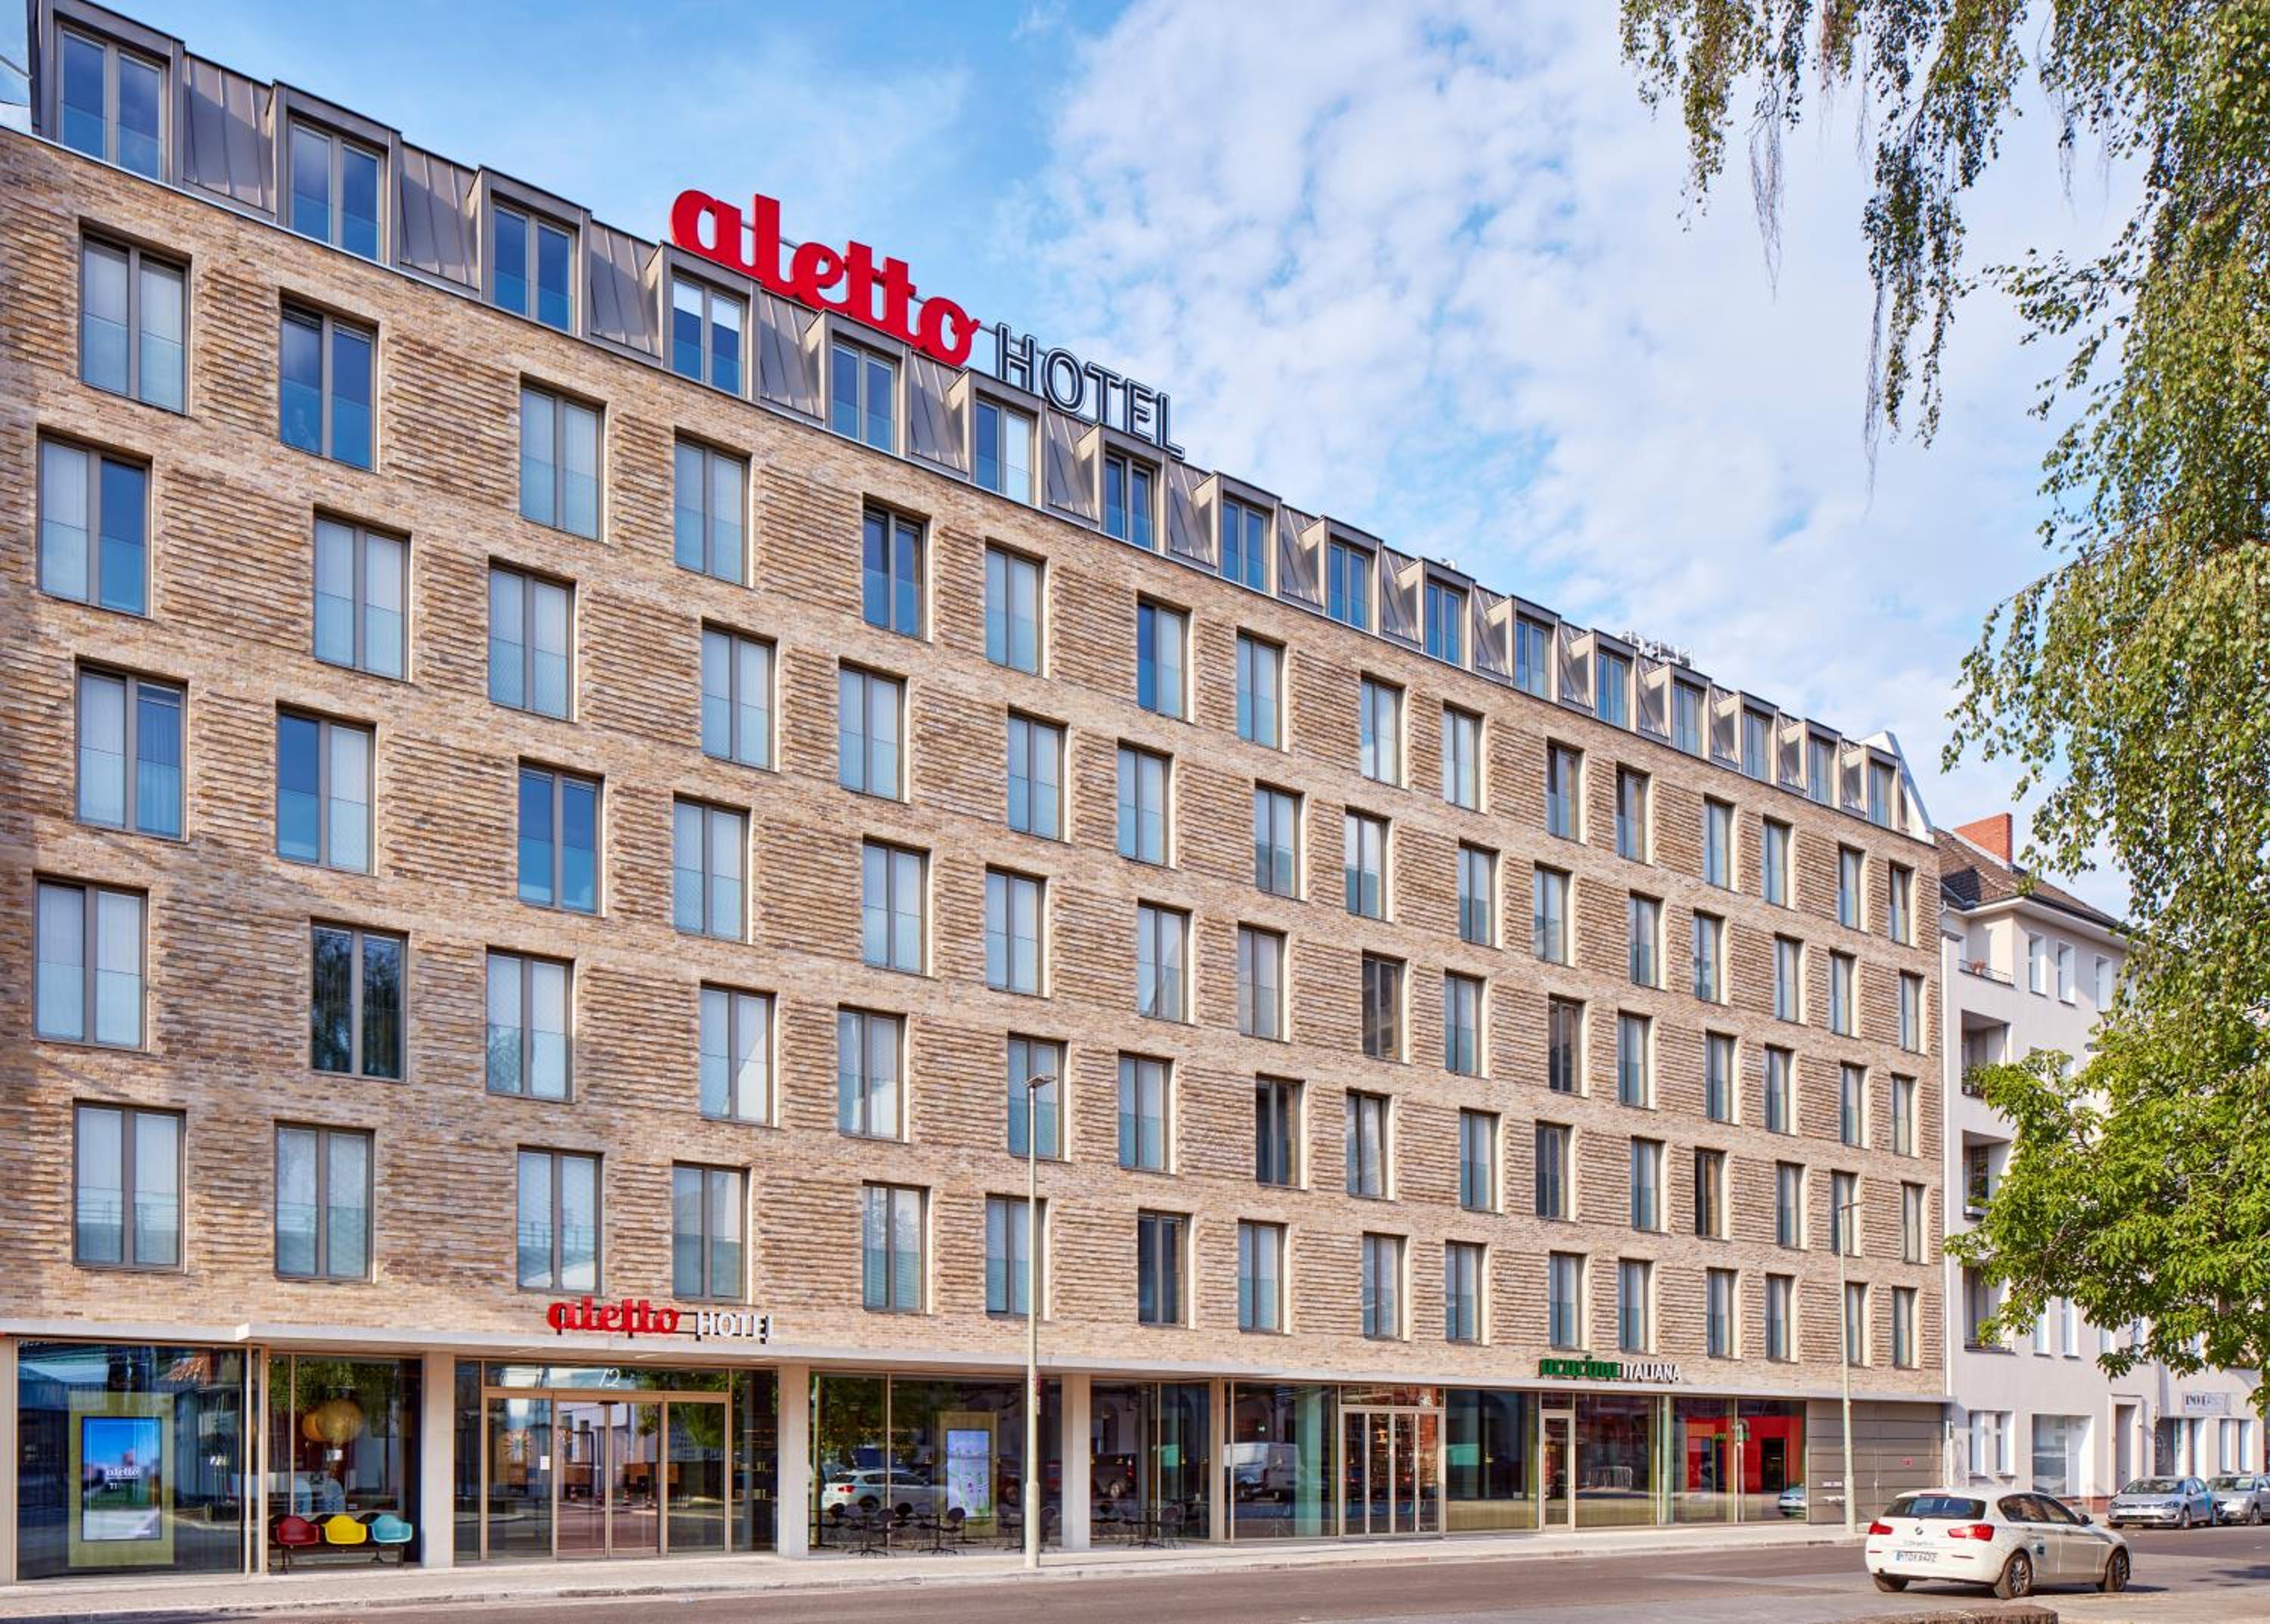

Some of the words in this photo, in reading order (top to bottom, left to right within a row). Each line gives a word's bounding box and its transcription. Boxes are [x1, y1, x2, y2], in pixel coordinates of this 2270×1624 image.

[670, 189, 980, 367] aletto
[995, 322, 1186, 460] HOTEL
[547, 1296, 679, 1333] aletto
[697, 1308, 775, 1341] HOTEL
[1622, 1361, 1681, 1382] ITALIANA
